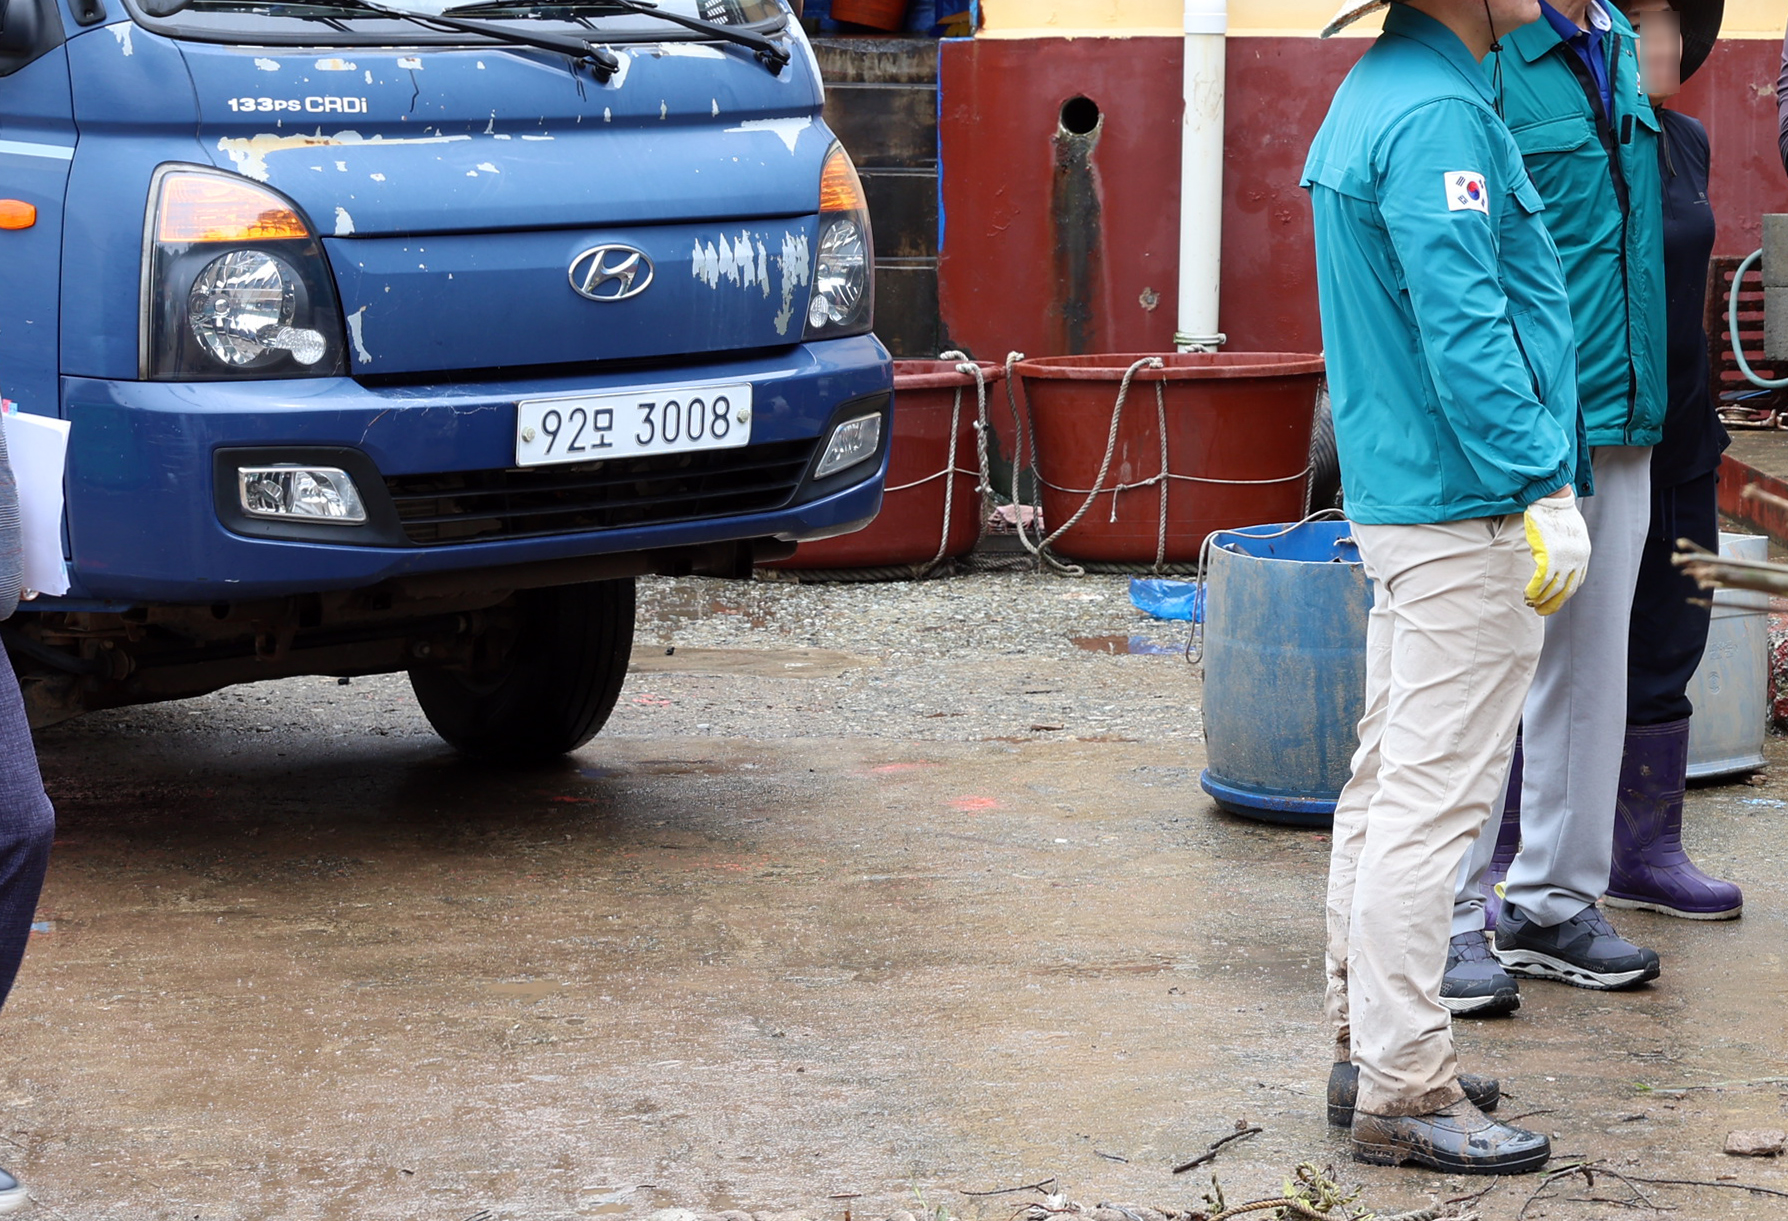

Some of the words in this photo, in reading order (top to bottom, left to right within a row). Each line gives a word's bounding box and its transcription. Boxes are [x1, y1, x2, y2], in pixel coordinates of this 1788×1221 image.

[304, 96, 368, 113] CRDi
[541, 406, 614, 456] 92모
[635, 395, 731, 447] 3008
